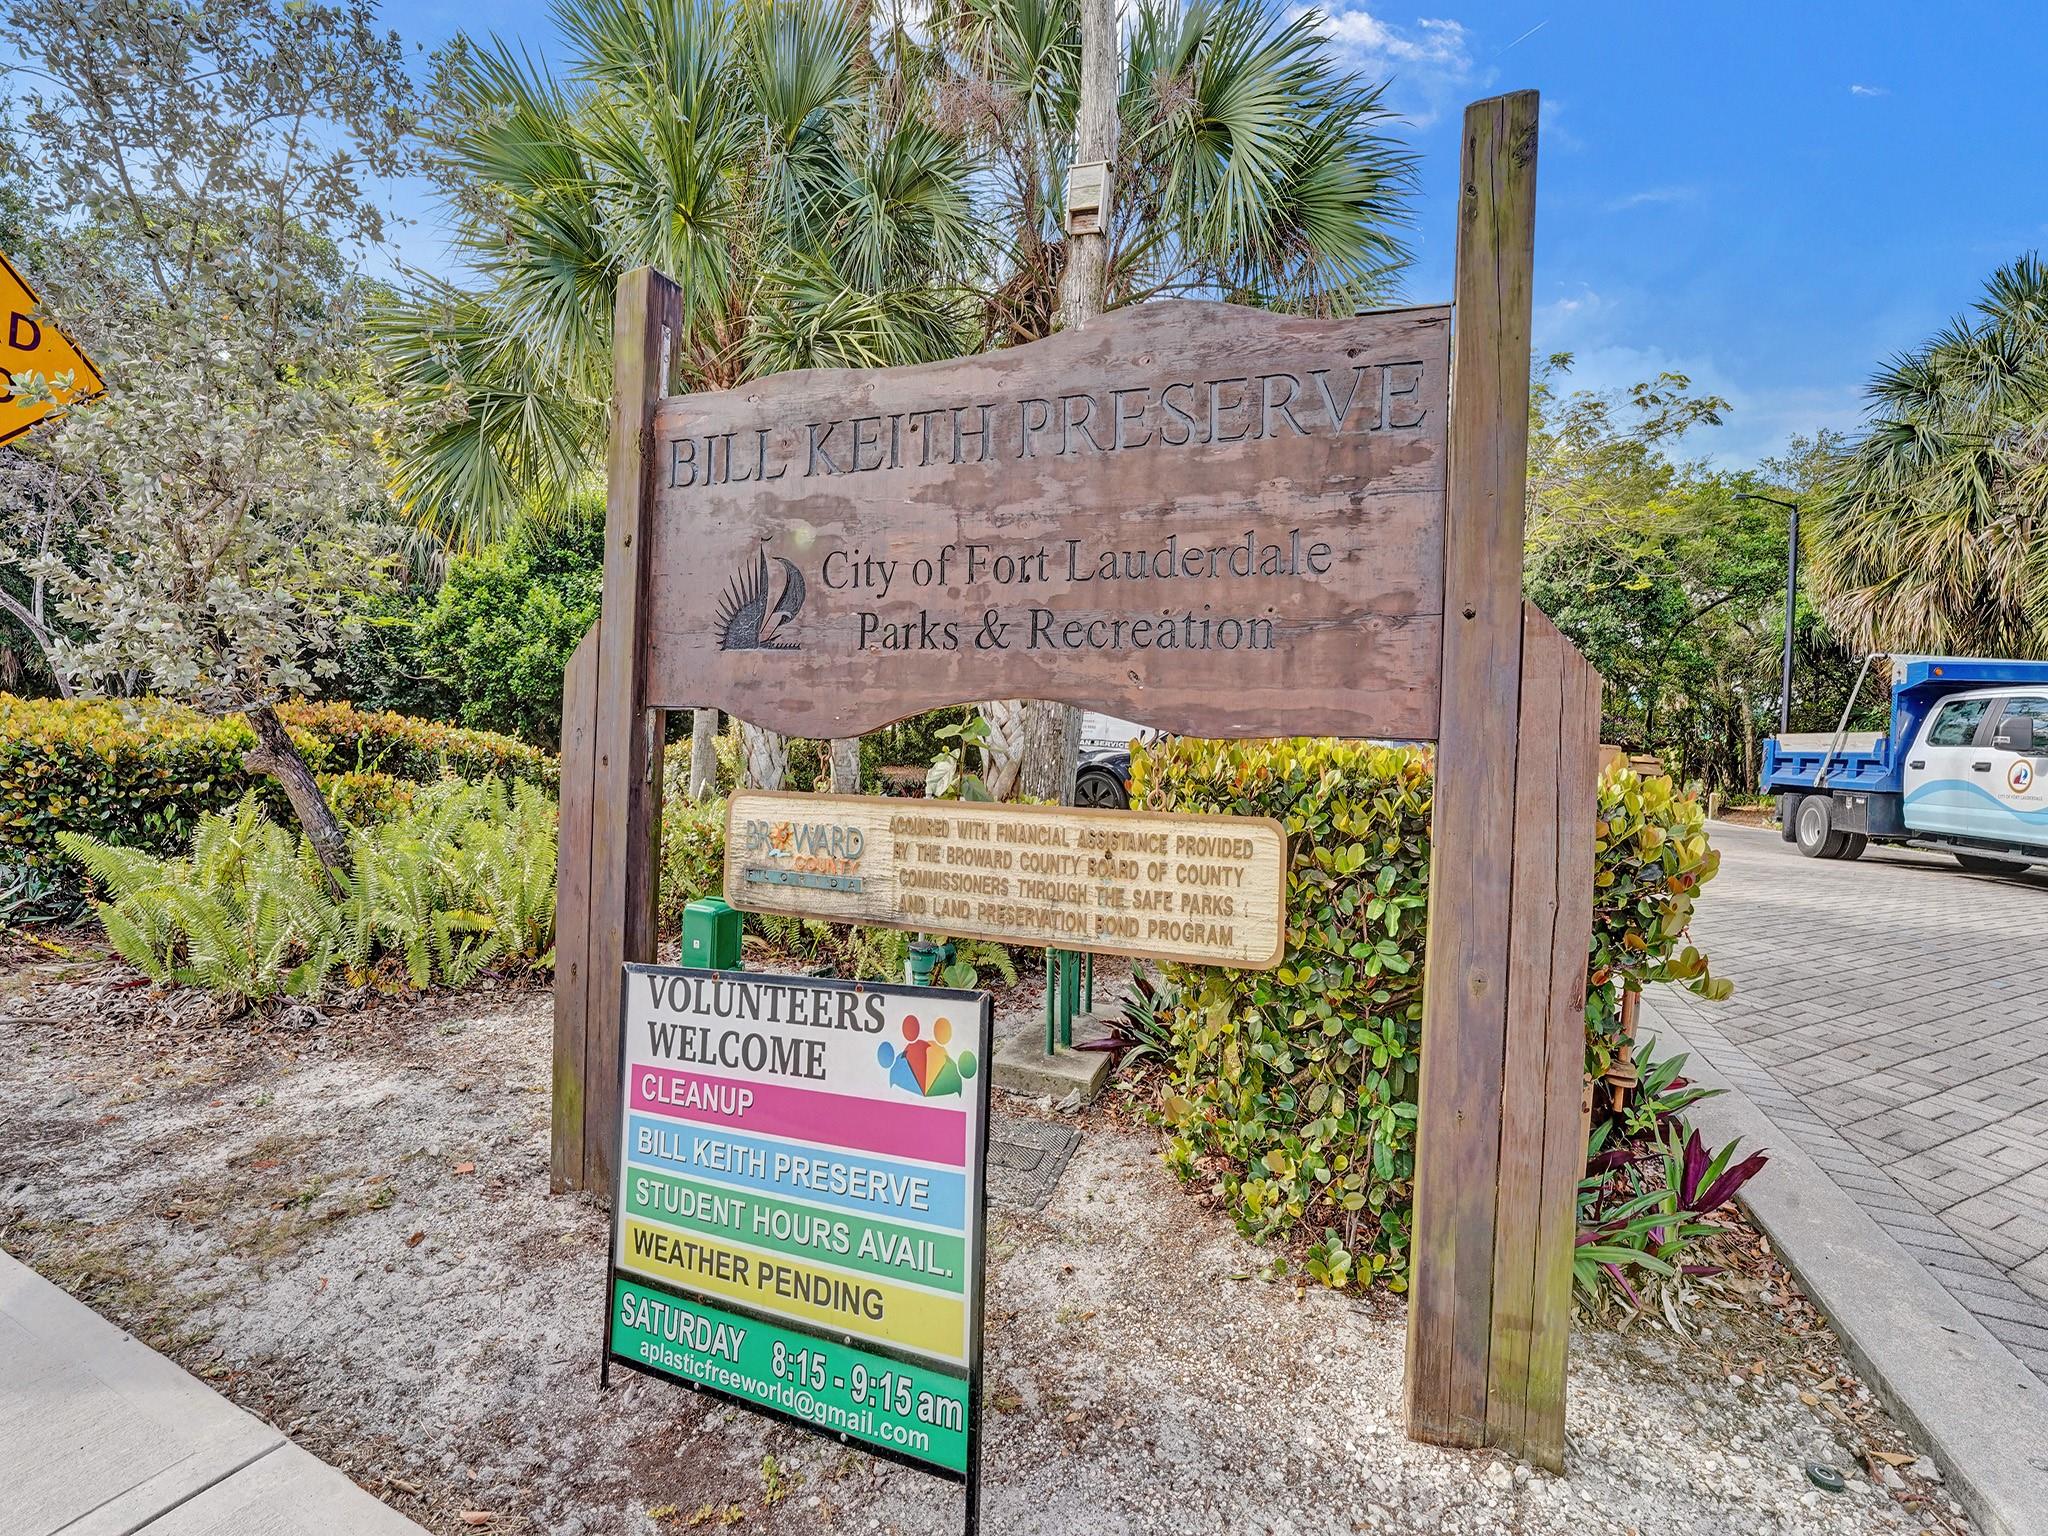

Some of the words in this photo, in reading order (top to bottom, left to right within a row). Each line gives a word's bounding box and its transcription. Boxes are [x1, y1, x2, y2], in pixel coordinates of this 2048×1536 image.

[668, 427, 788, 489] BILL
[804, 403, 997, 477] KEITH
[1016, 360, 1428, 459] PRESERVE
[822, 548, 899, 600] City
[912, 543, 956, 587] of
[964, 544, 1050, 585] Fort
[1064, 528, 1333, 583] Lauderdale
[857, 609, 959, 651] Parks
[974, 608, 1011, 650] &
[1027, 603, 1277, 651] Recreation
[793, 855, 862, 877] COUNTY
[889, 816, 950, 838] ACQUIRED
[957, 820, 990, 841] WITH
[996, 823, 1070, 847] FINANCIAL
[1077, 828, 1168, 855] ASSISTANCE
[1176, 834, 1254, 859] PROVIDED
[893, 841, 909, 862] BY
[916, 843, 941, 864] THE
[946, 845, 1013, 870] BROWARD
[1020, 851, 1081, 876] COUNTY
[1087, 856, 1139, 880] BOARD
[1147, 862, 1169, 882] OF
[1176, 863, 1245, 888] COUNTY
[899, 868, 1010, 897] COMMISSIONERS
[1018, 877, 1088, 904] THROUGH
[1095, 885, 1125, 908] THE
[1132, 888, 1173, 912] SAFE
[1181, 892, 1234, 917] PARKS
[900, 893, 926, 915] AND
[933, 897, 971, 919] LAND
[977, 901, 1088, 933] PRESERVATION
[1094, 915, 1140, 938] BOND
[1147, 919, 1234, 946] PROGRAM
[647, 975, 886, 1034] VOLUNTEERS
[647, 1020, 827, 1081] WELCOME
[641, 1073, 754, 1117] CLEANUP
[638, 1126, 687, 1163] BILL
[693, 1135, 768, 1180] KEITH
[774, 1152, 931, 1212] PRESERVE
[635, 1176, 746, 1230] STUDENT
[753, 1203, 851, 1255] HOURS
[857, 1227, 955, 1279] AVAIL.
[633, 1227, 750, 1287] WEATHER
[757, 1261, 884, 1321] PENDING
[621, 1291, 747, 1363] SATURDAY
[770, 1340, 828, 1392] 8:15
[833, 1375, 845, 1390] -
[850, 1363, 915, 1417] 9:15
[916, 1386, 964, 1432] am
[639, 1338, 931, 1452] aplasticfreeworld@gmail.com
